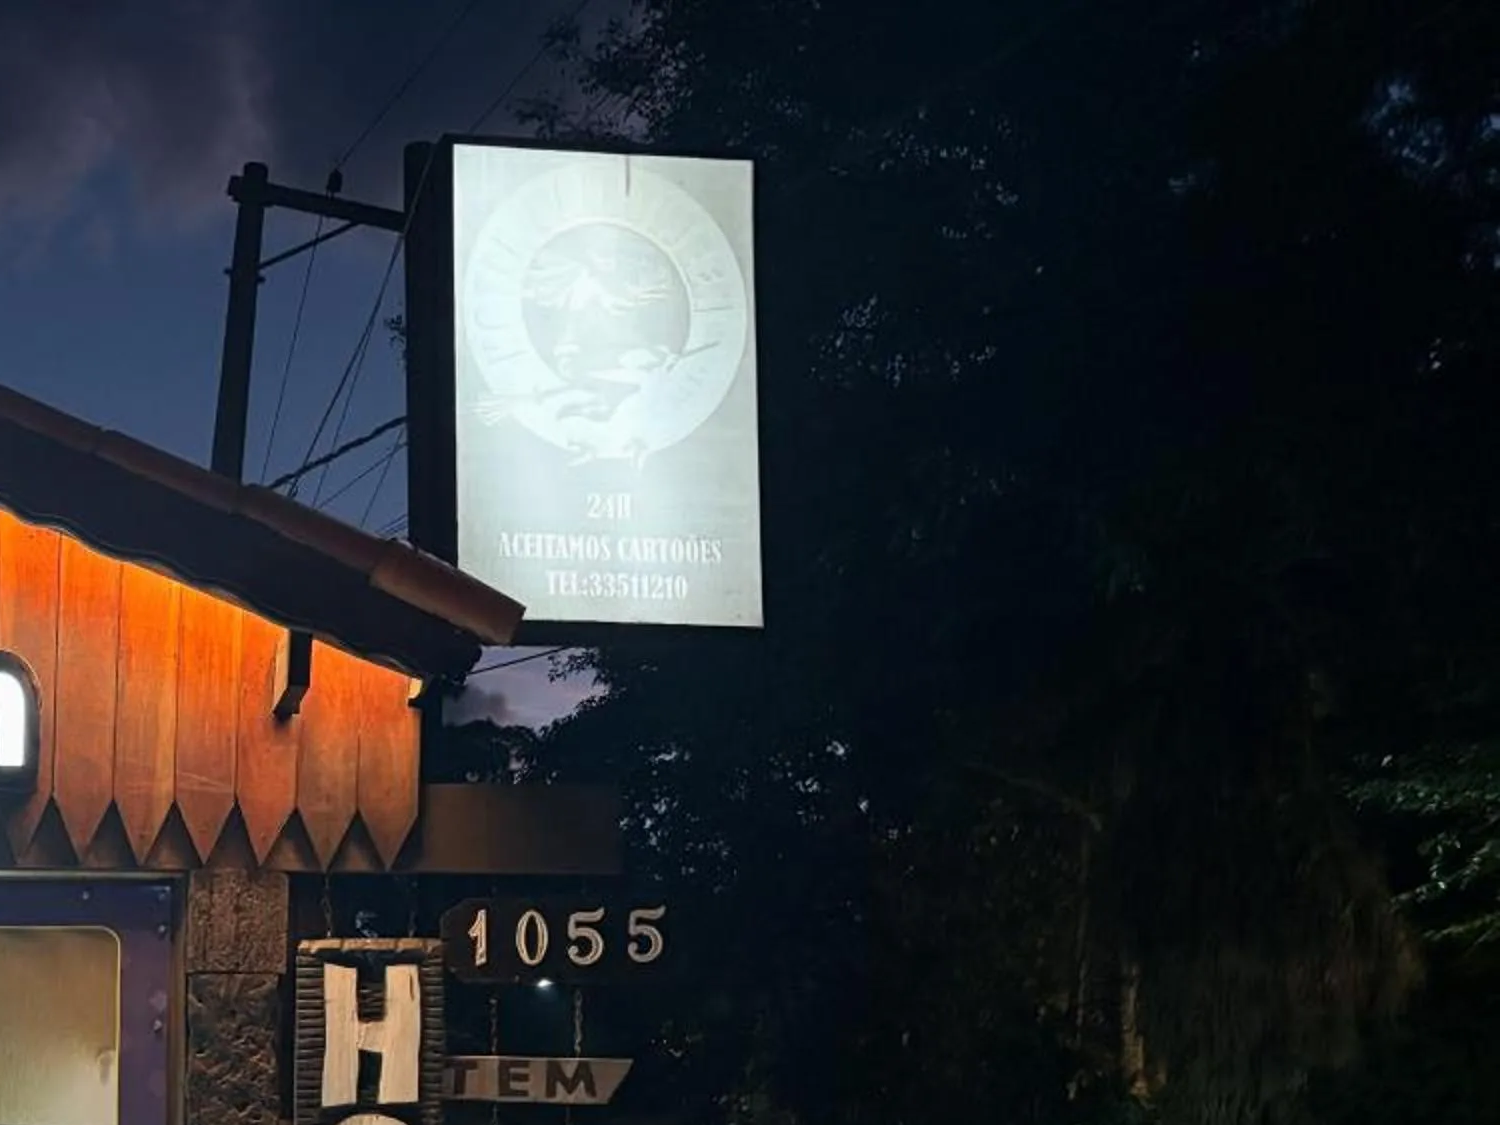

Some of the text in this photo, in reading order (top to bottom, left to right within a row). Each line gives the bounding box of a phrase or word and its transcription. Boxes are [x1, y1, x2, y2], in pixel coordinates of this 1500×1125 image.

[499, 531, 611, 561] ACEITAMOS
[467, 904, 667, 967] 1055
[445, 1060, 598, 1098] TEM
